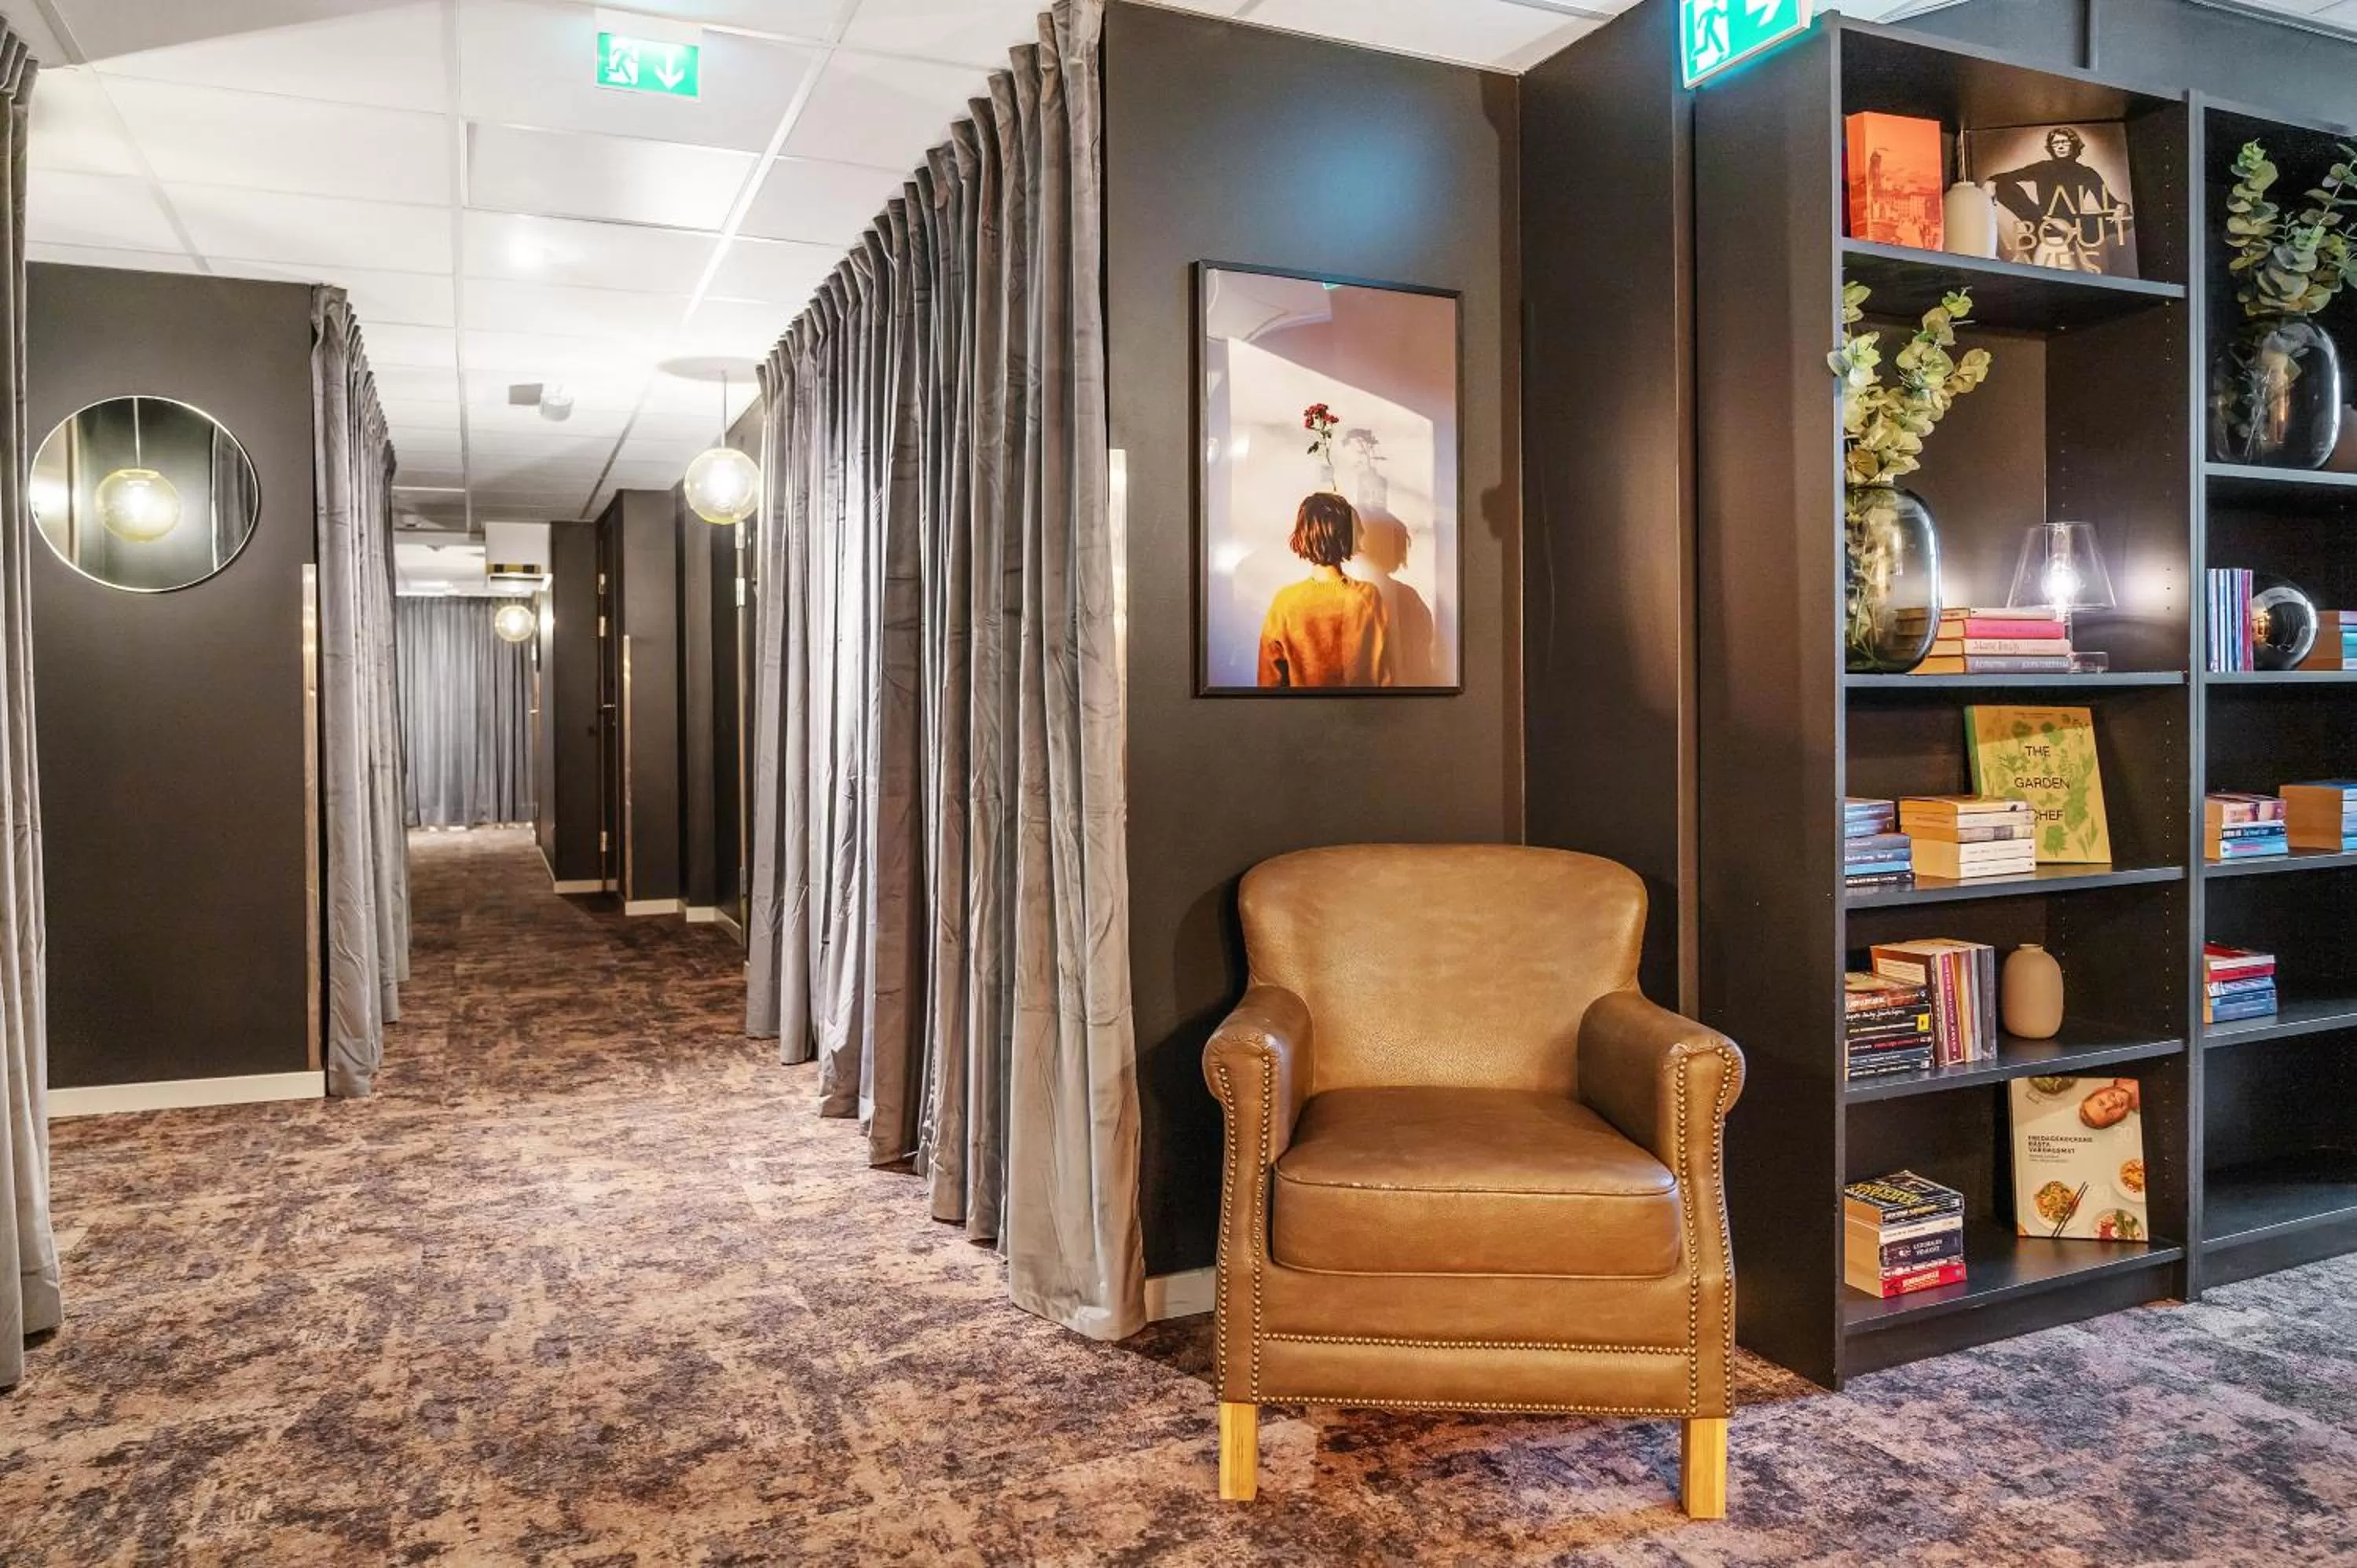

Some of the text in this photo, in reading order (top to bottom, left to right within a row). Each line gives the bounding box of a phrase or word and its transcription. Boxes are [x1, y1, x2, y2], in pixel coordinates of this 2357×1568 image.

[2047, 184, 2117, 215] ALL
[2025, 746, 2051, 757] THE
[2014, 777, 2070, 789] GARDEN
